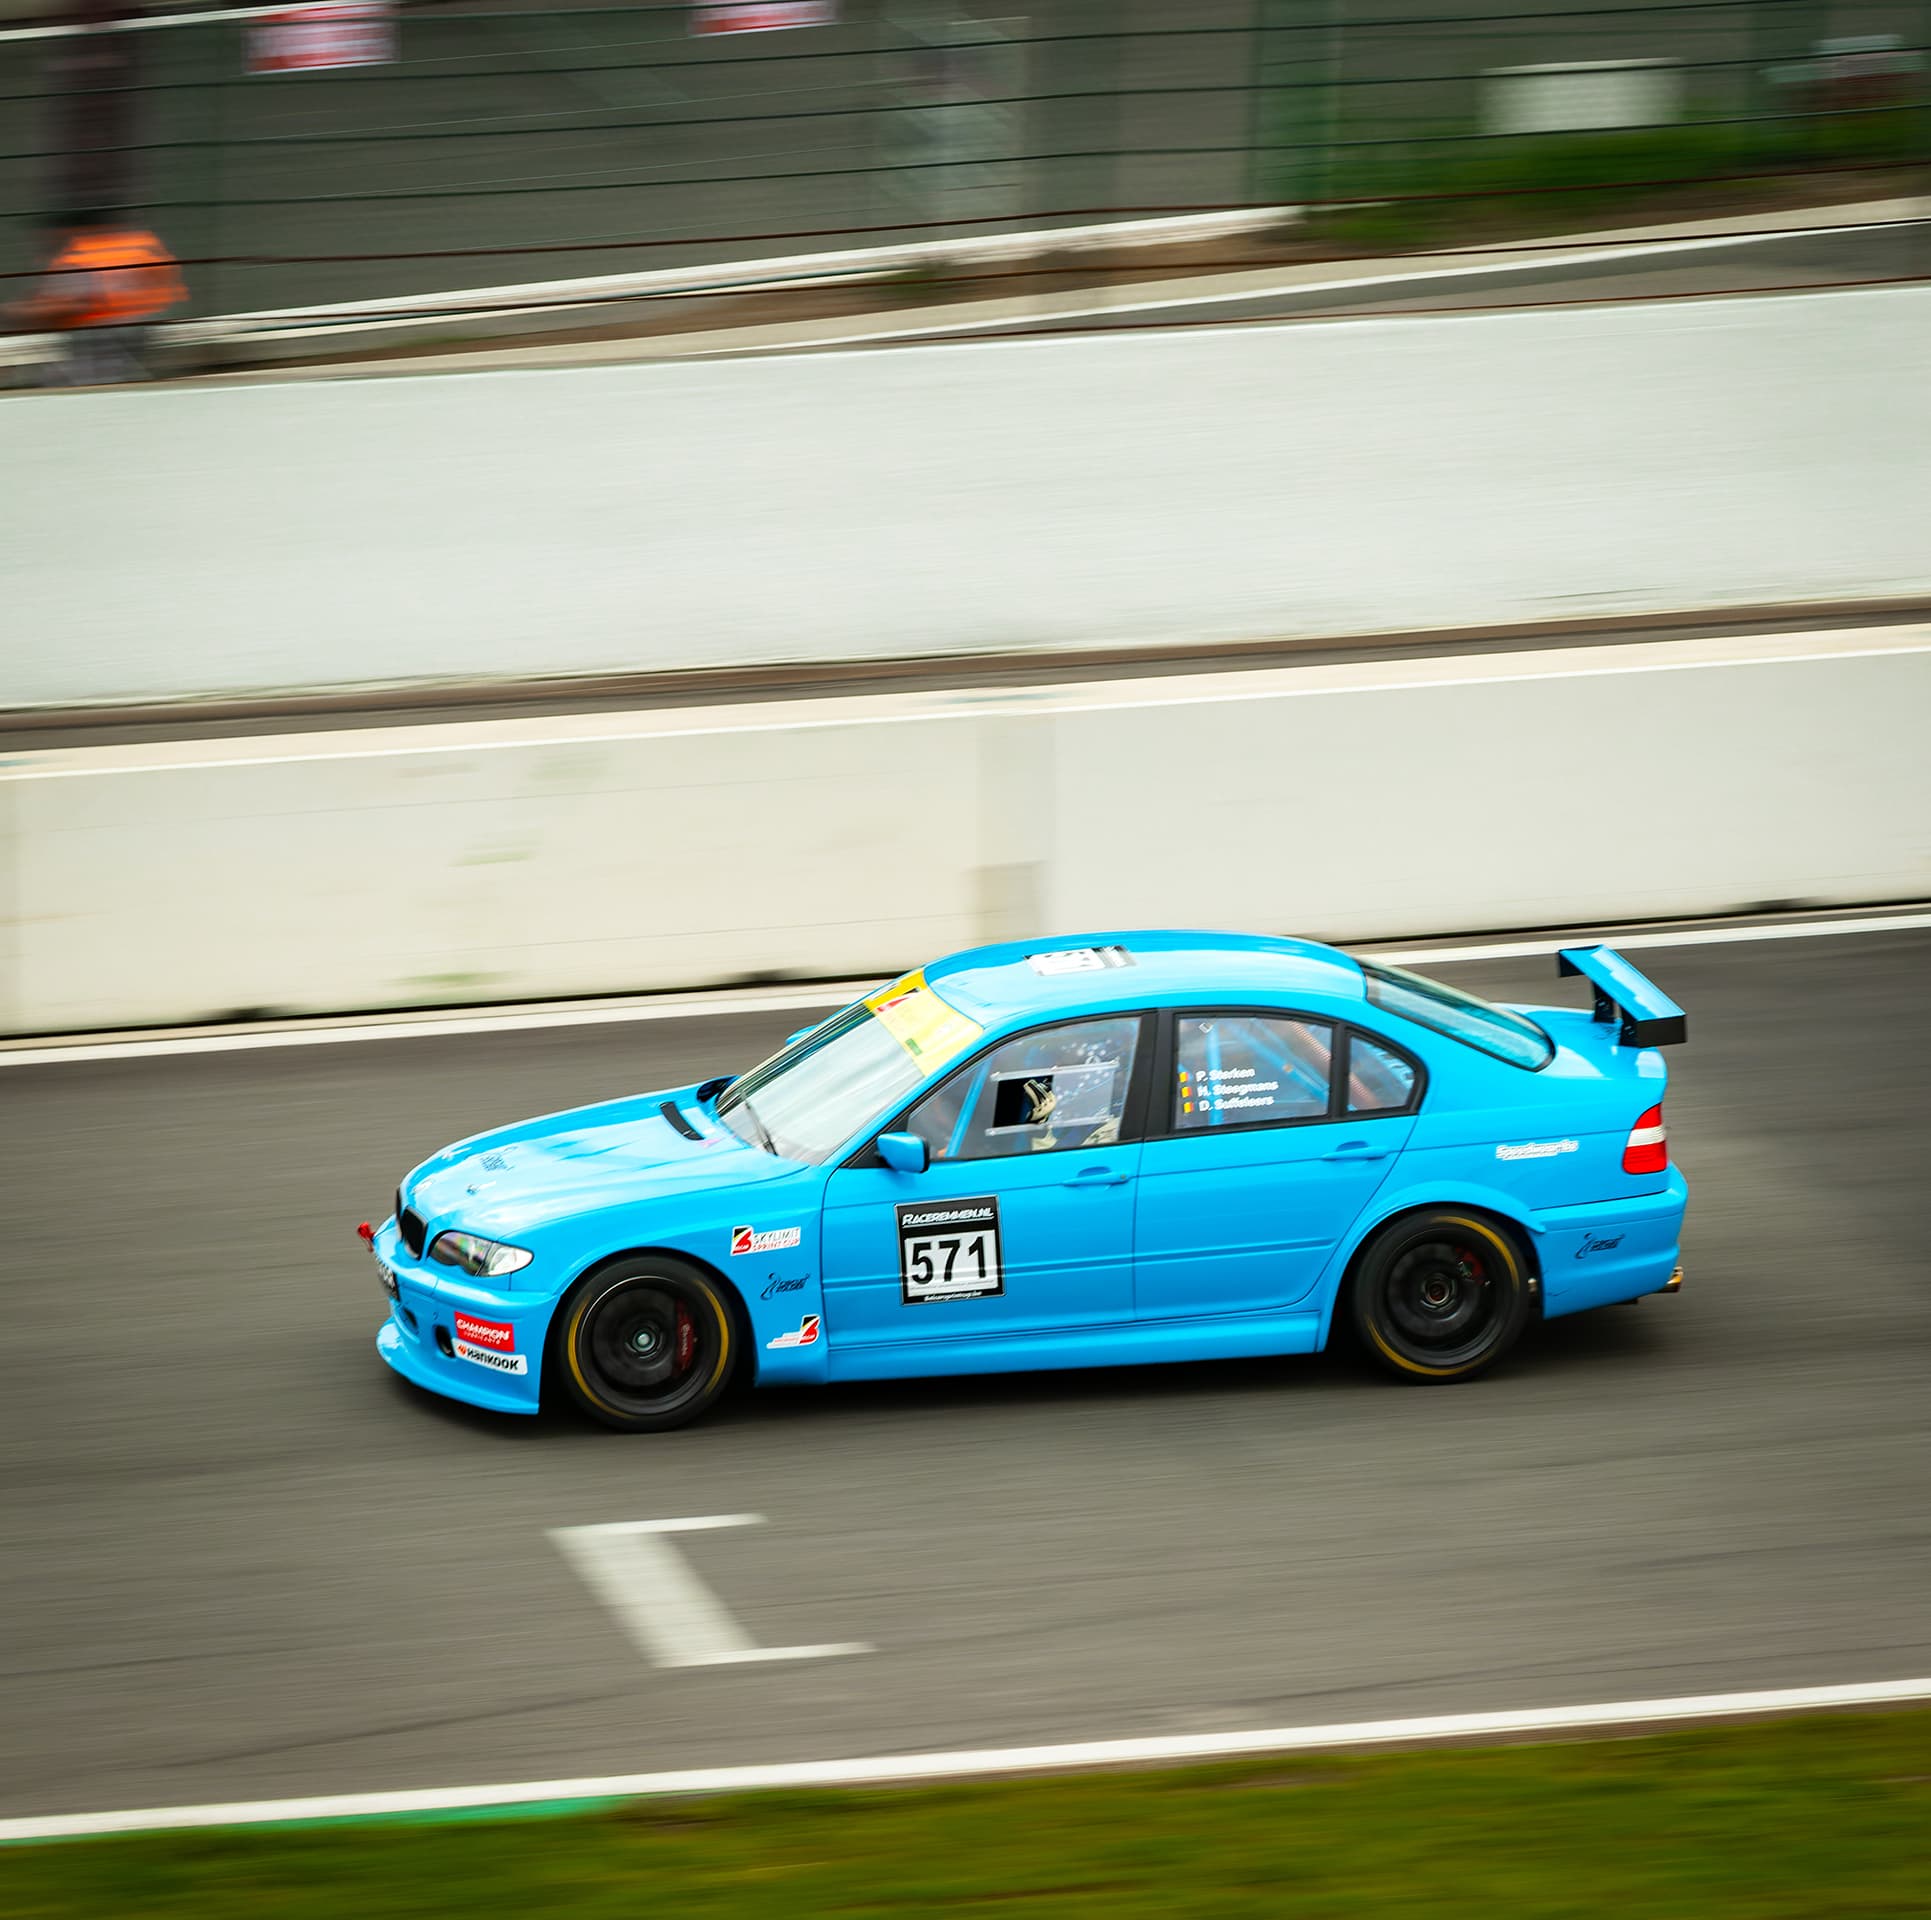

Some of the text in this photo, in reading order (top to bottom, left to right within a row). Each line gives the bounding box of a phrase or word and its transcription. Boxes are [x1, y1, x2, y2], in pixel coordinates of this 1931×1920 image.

[1195, 1070, 1208, 1082] P.
[1199, 1100, 1213, 1112] D.
[911, 1235, 987, 1285] 571
